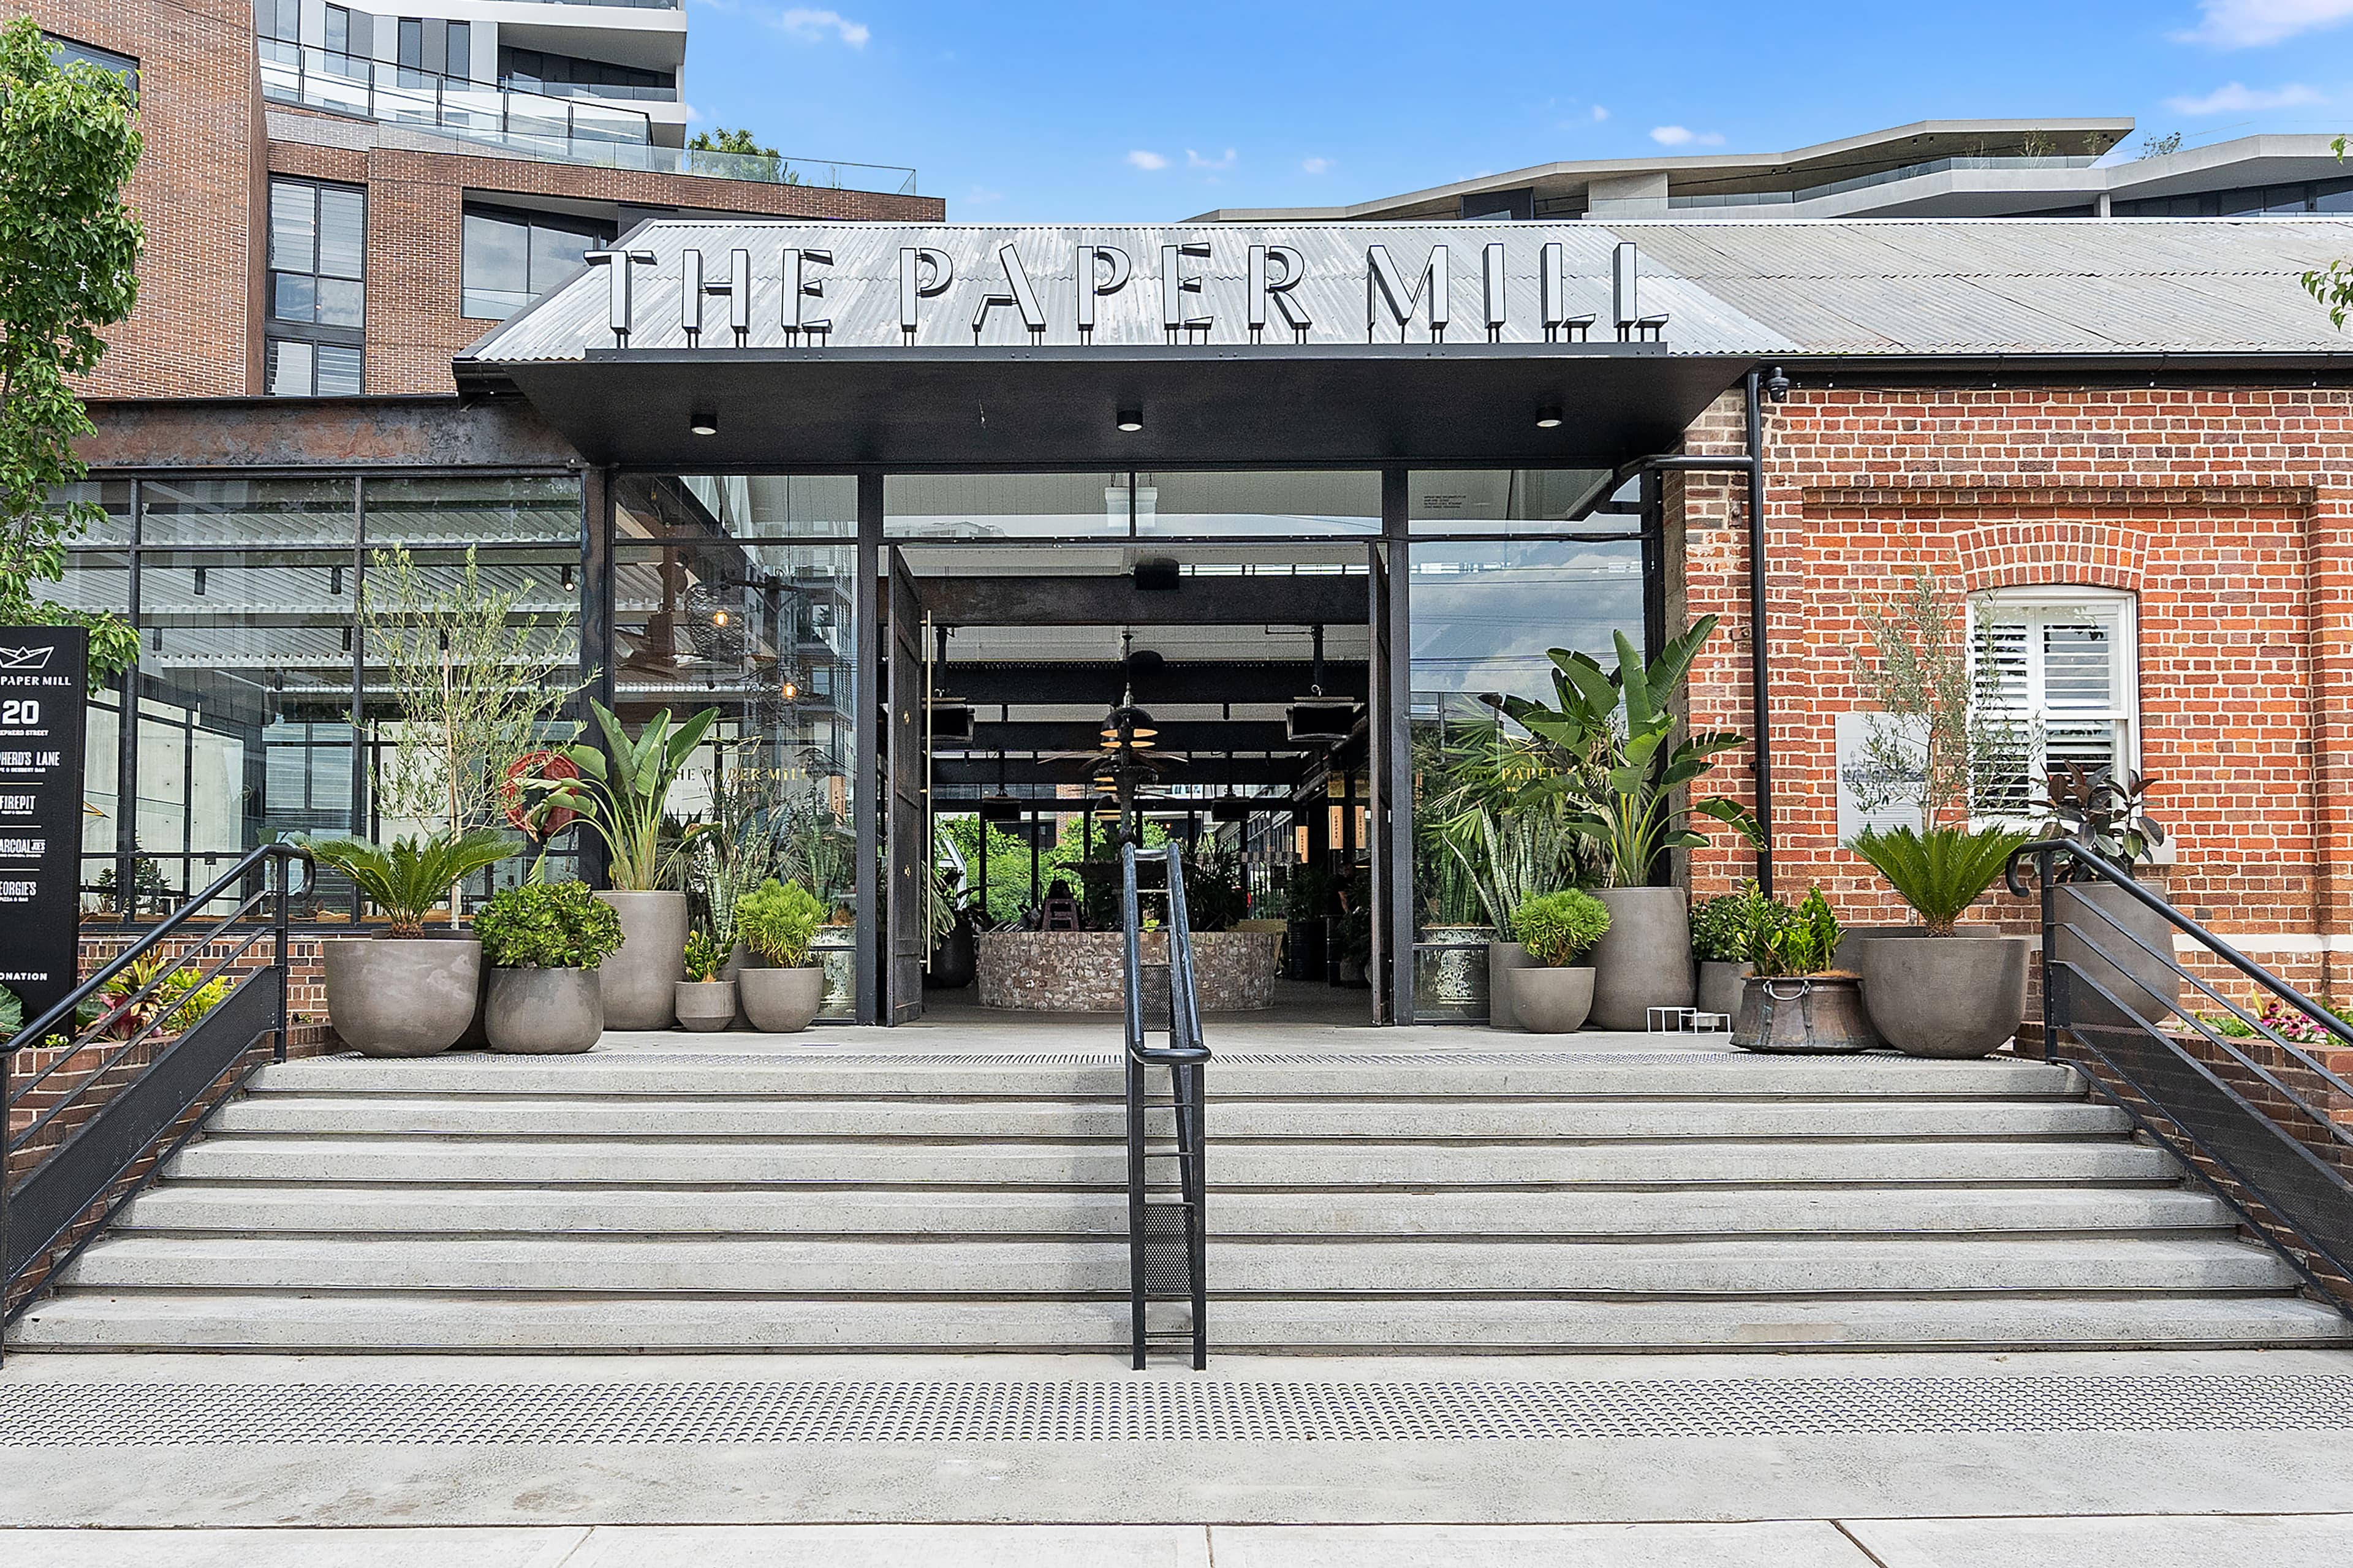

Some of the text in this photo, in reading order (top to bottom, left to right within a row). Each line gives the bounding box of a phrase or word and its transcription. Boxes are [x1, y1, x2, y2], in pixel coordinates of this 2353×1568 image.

[583, 242, 1669, 335] THE PAPER MILL
[1, 676, 72, 686] PAPER MILL
[2, 700, 40, 724] 20
[0, 751, 60, 766] HERD'S LANE
[0, 795, 36, 810] FIREPIT
[0, 972, 48, 981] ONATION
